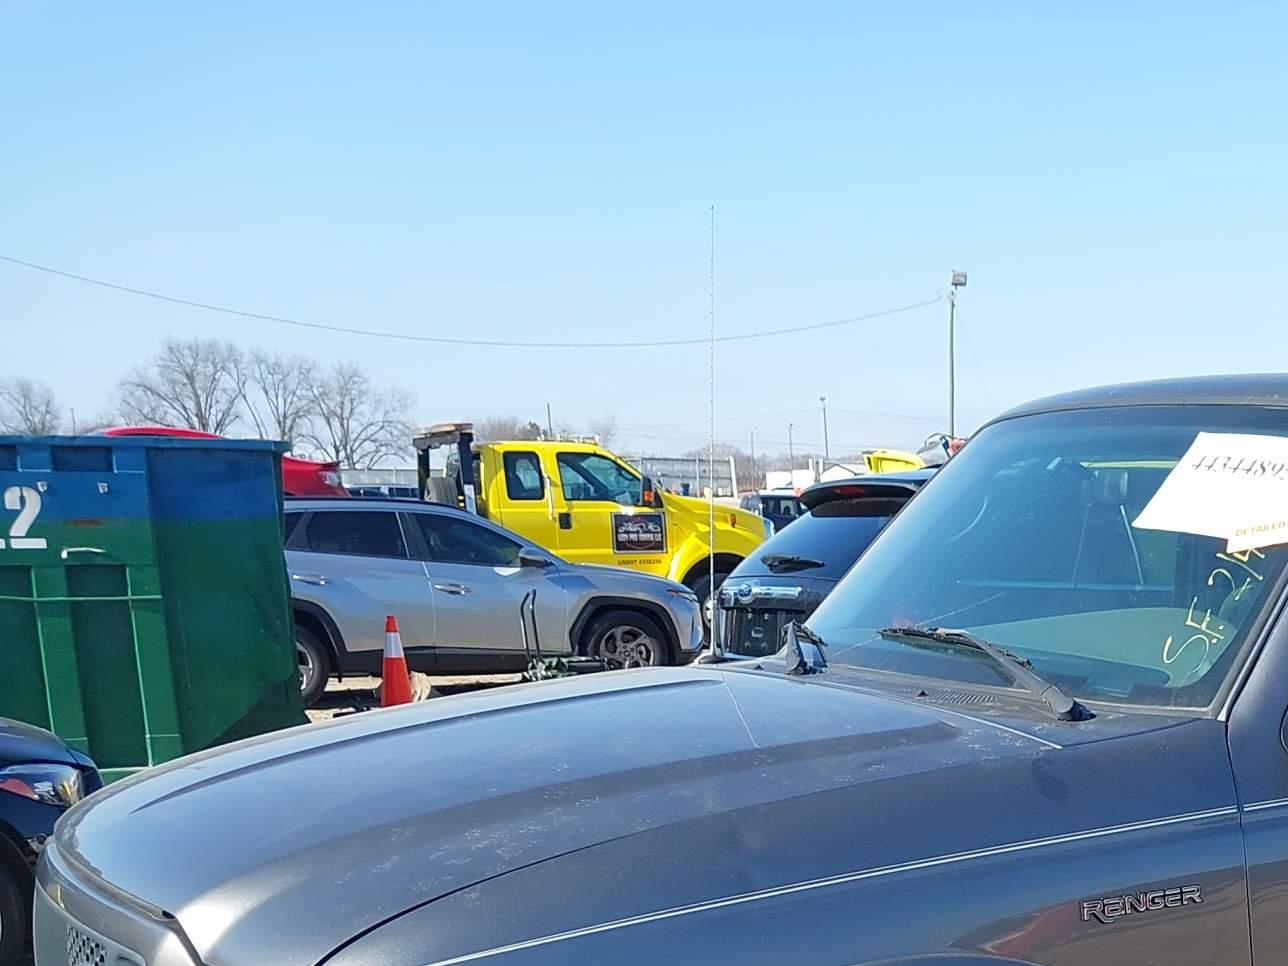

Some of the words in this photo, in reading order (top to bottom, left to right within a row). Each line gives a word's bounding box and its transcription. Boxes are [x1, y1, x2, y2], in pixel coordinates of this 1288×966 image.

[0, 486, 47, 549] 2
[1234, 520, 1287, 538] DETAILED
[1081, 883, 1203, 924] RANGER
